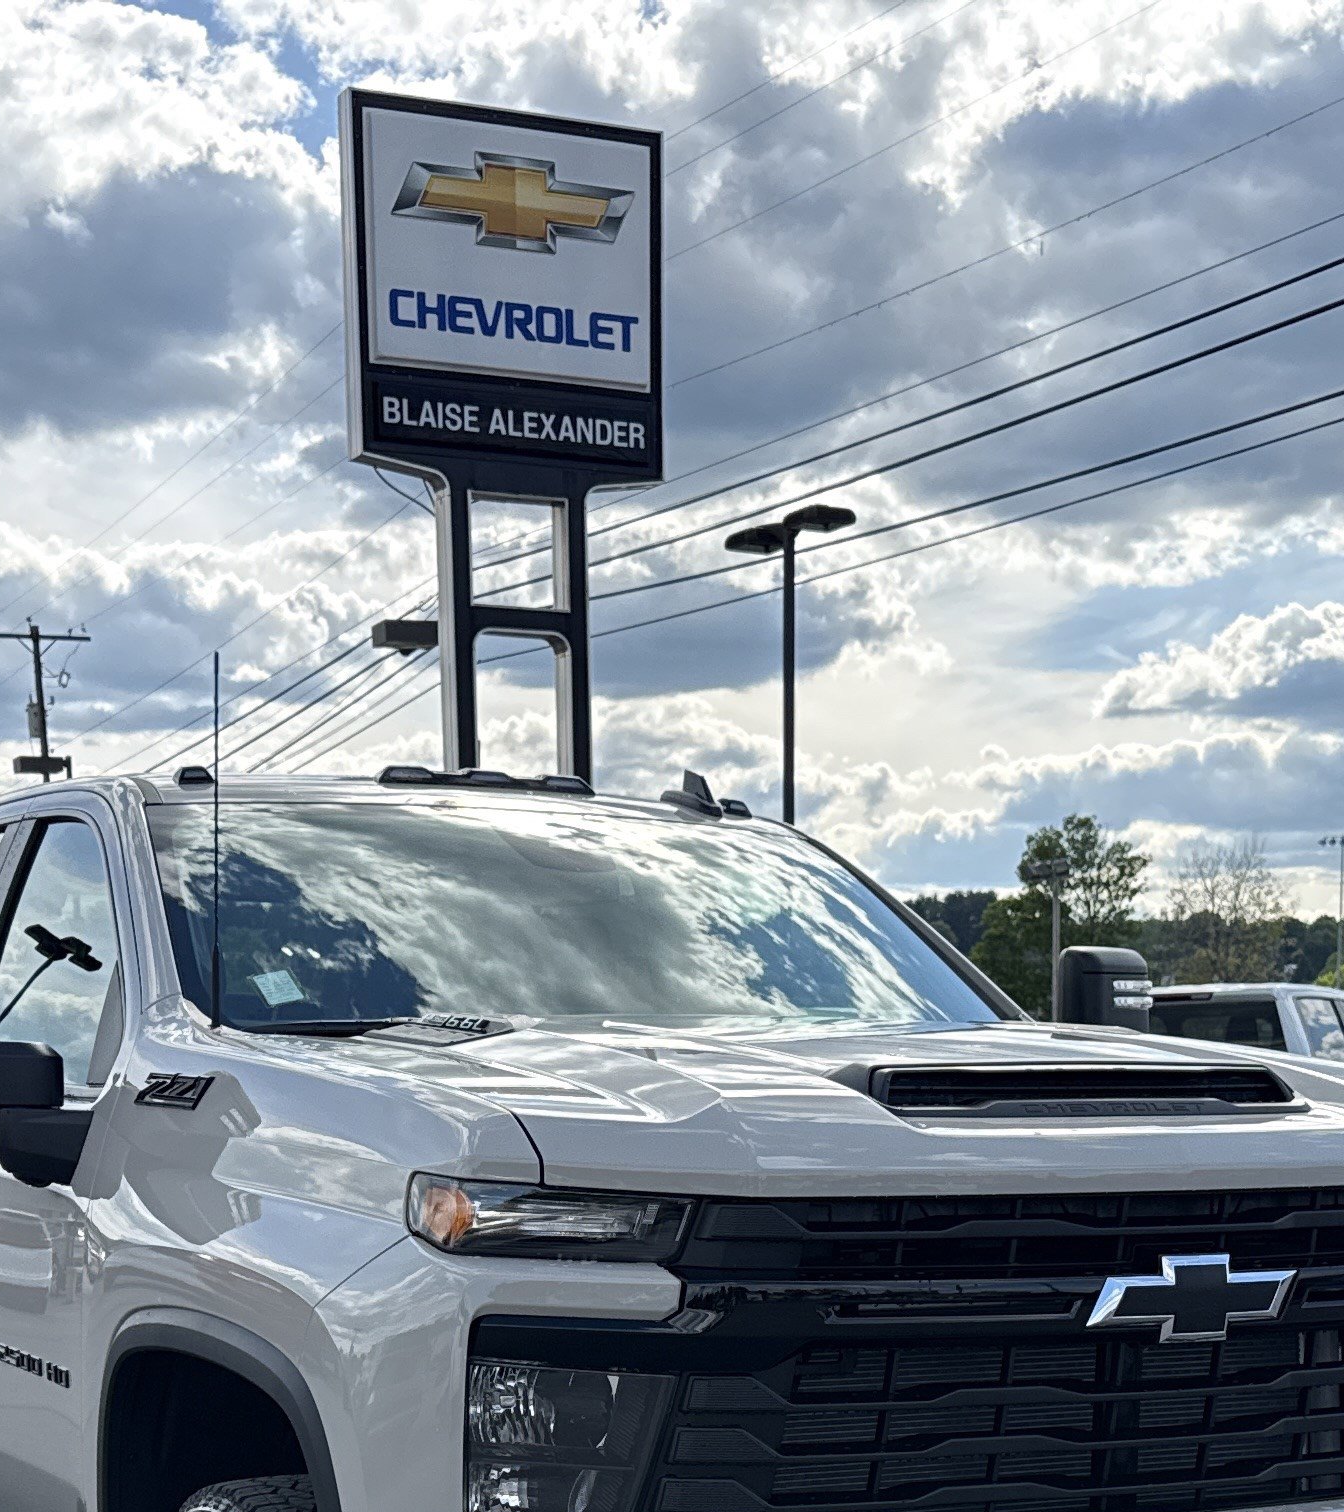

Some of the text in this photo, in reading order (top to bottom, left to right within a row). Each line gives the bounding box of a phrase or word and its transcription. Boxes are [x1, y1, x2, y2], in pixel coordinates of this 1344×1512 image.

[389, 287, 639, 353] CHEVROLET
[382, 396, 646, 450] BLAISE ALEXANDER
[1022, 1102, 1205, 1114] CHEVROLET
[46, 1361, 70, 1389] HD
